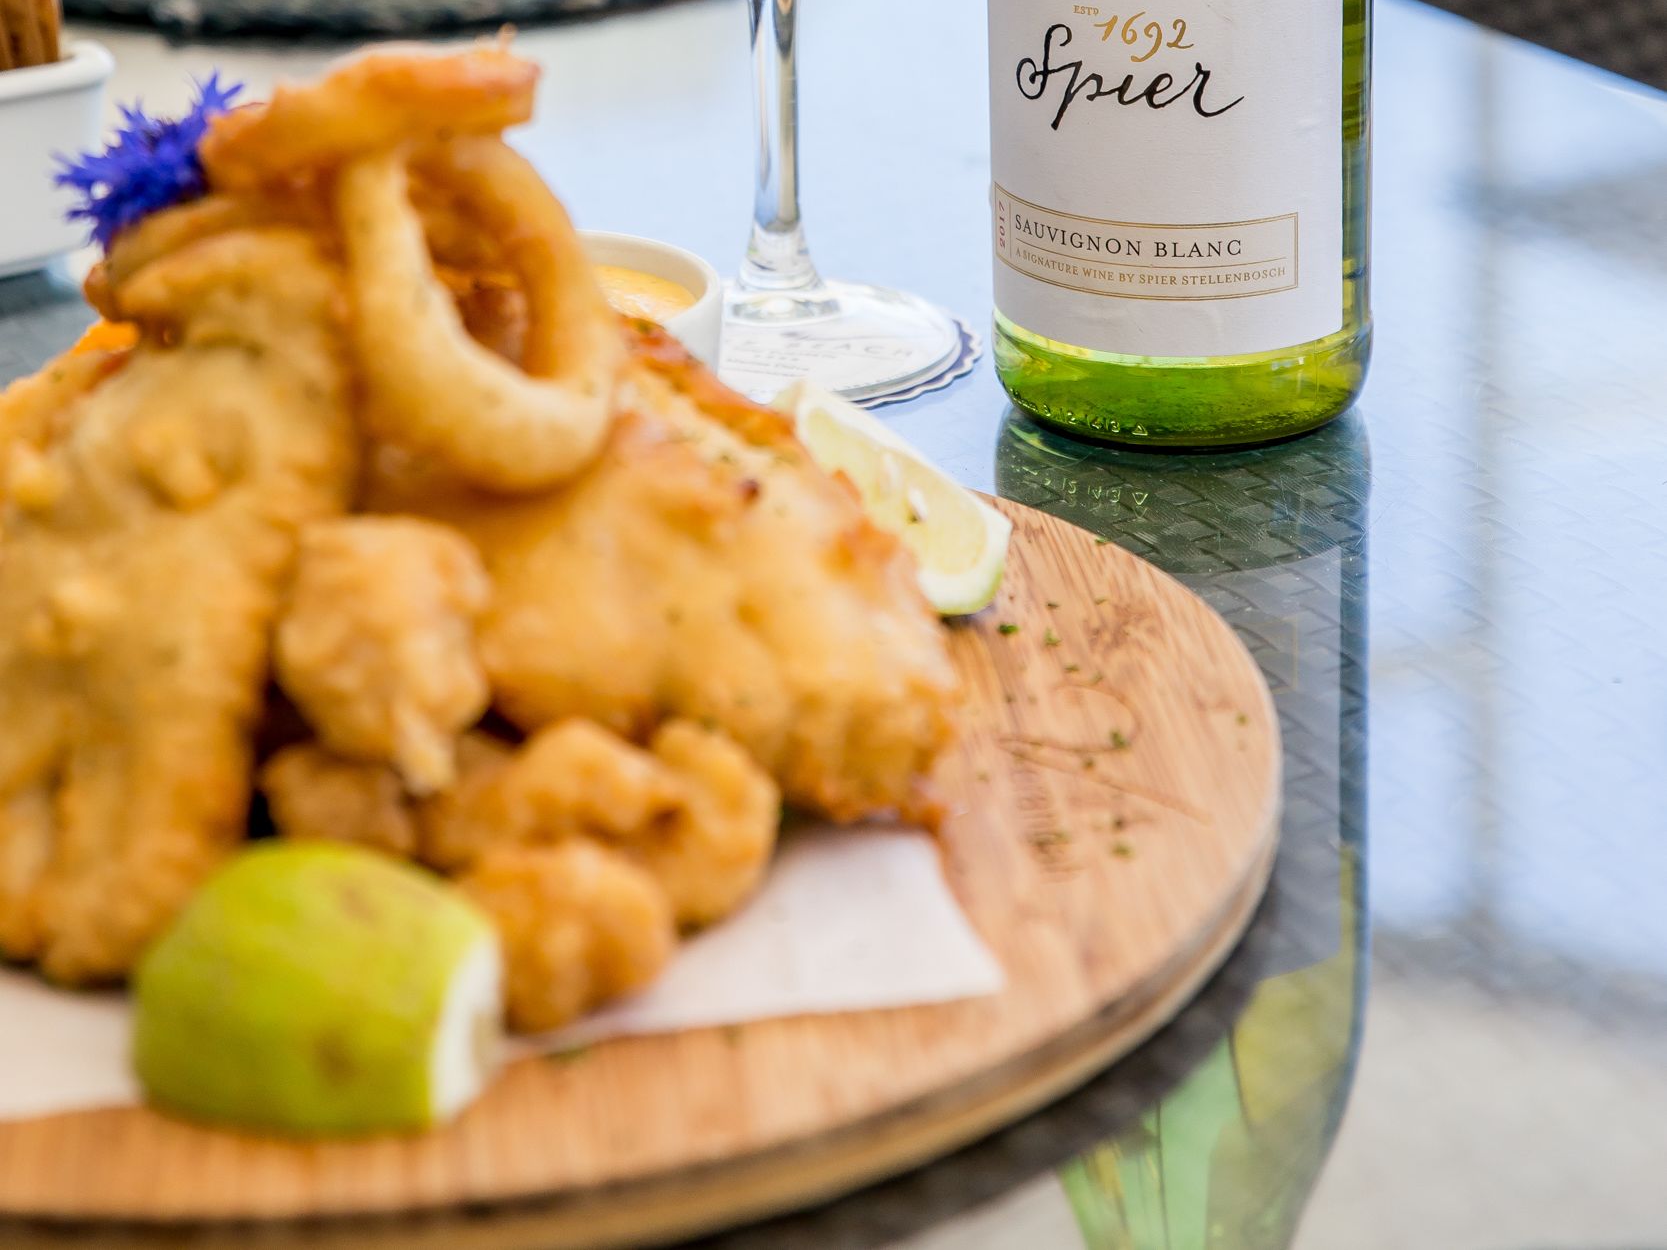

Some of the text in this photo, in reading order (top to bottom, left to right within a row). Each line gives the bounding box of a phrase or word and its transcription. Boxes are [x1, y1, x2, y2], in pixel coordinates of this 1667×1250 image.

[1094, 11, 1194, 63] 1692
[1016, 23, 1245, 131] Spier
[1014, 214, 1242, 258] SAUVIGNON BLANC
[1022, 252, 1079, 276] SIGNATURE
[1082, 267, 1115, 282] WINE
[1118, 271, 1136, 284] BY
[1138, 273, 1178, 286] SPIER
[1181, 266, 1286, 286] STELLENBOSCH
